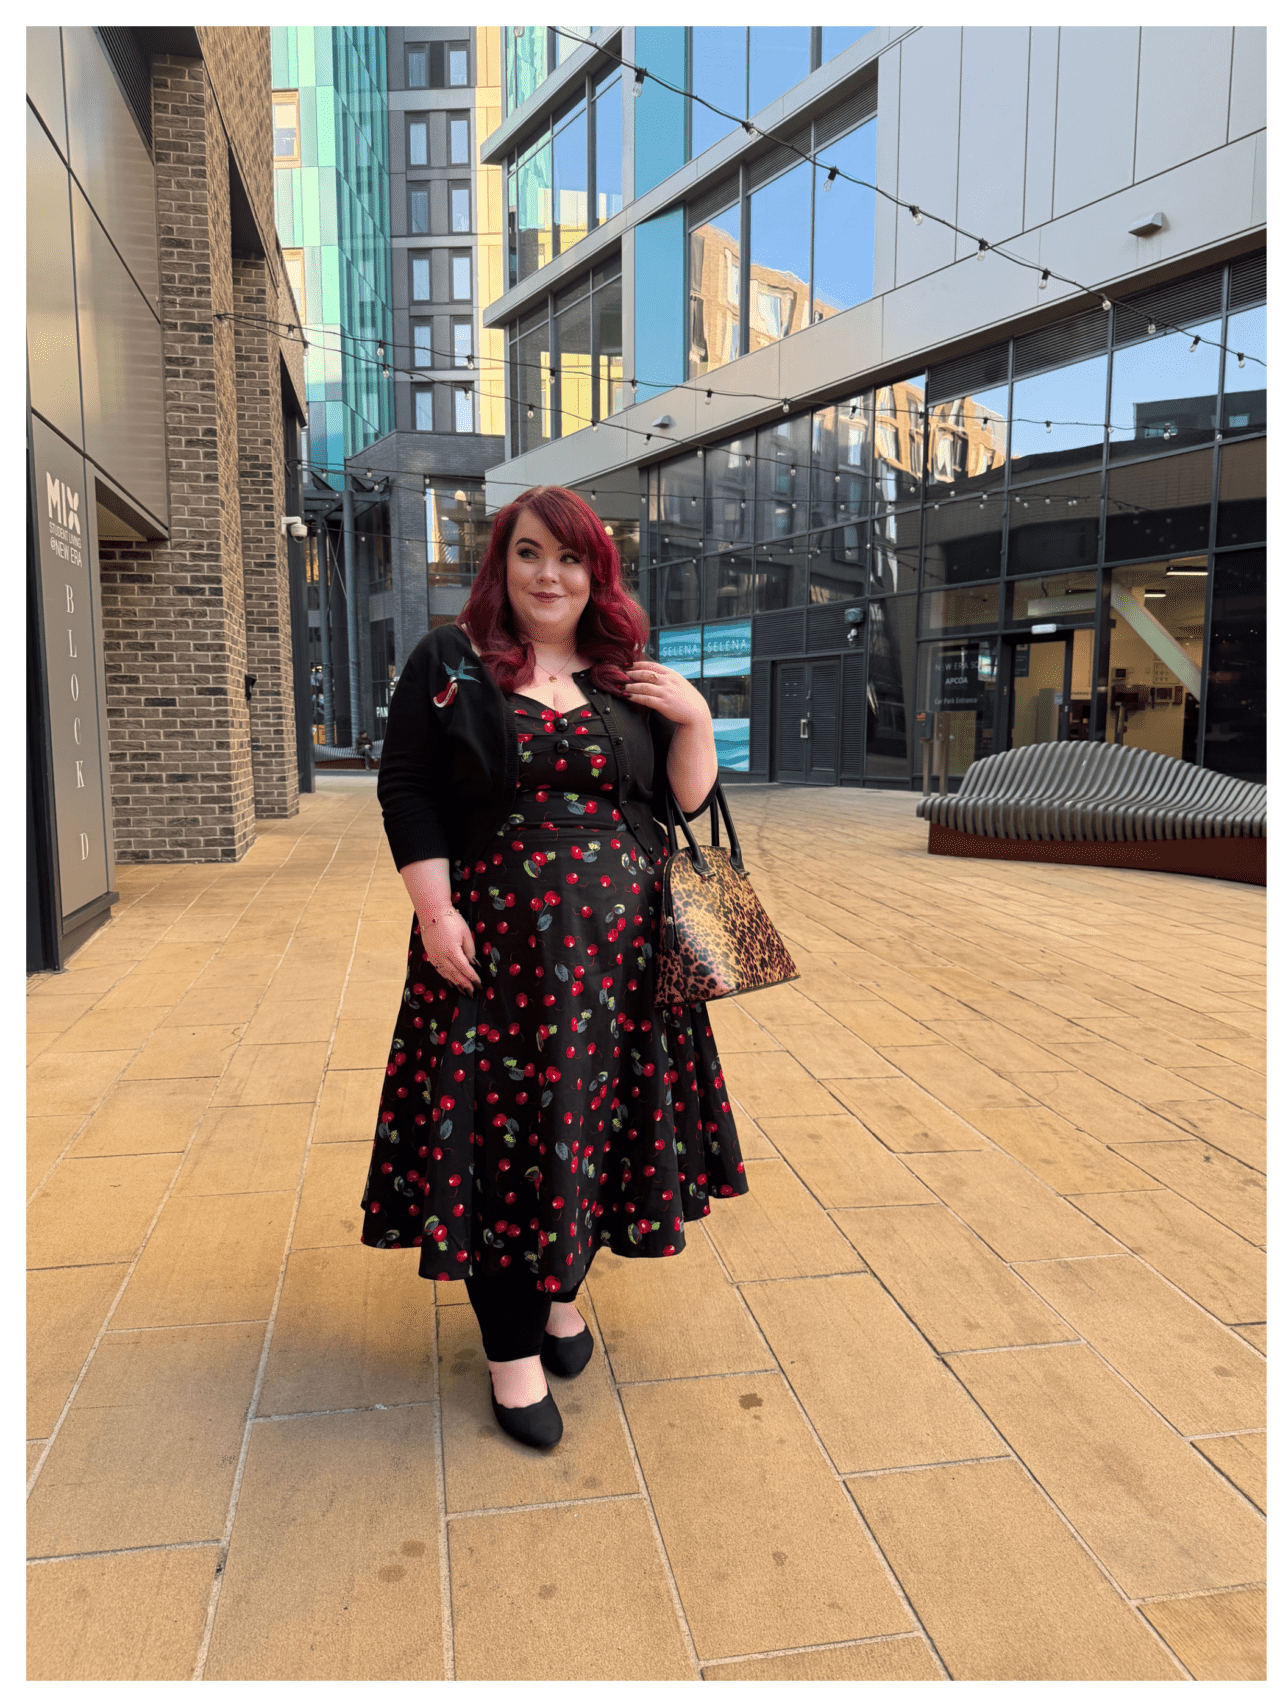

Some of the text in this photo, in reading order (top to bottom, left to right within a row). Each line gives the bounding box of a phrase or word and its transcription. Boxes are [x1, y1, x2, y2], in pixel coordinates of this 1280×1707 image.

[46, 471, 80, 536] MIX
[49, 521, 68, 542] STUDENT
[50, 536, 83, 568] @NEW ERA
[662, 644, 698, 657] SELENA
[706, 639, 747, 653] SELENA
[65, 584, 85, 789] BLOCK
[79, 832, 89, 861] D
